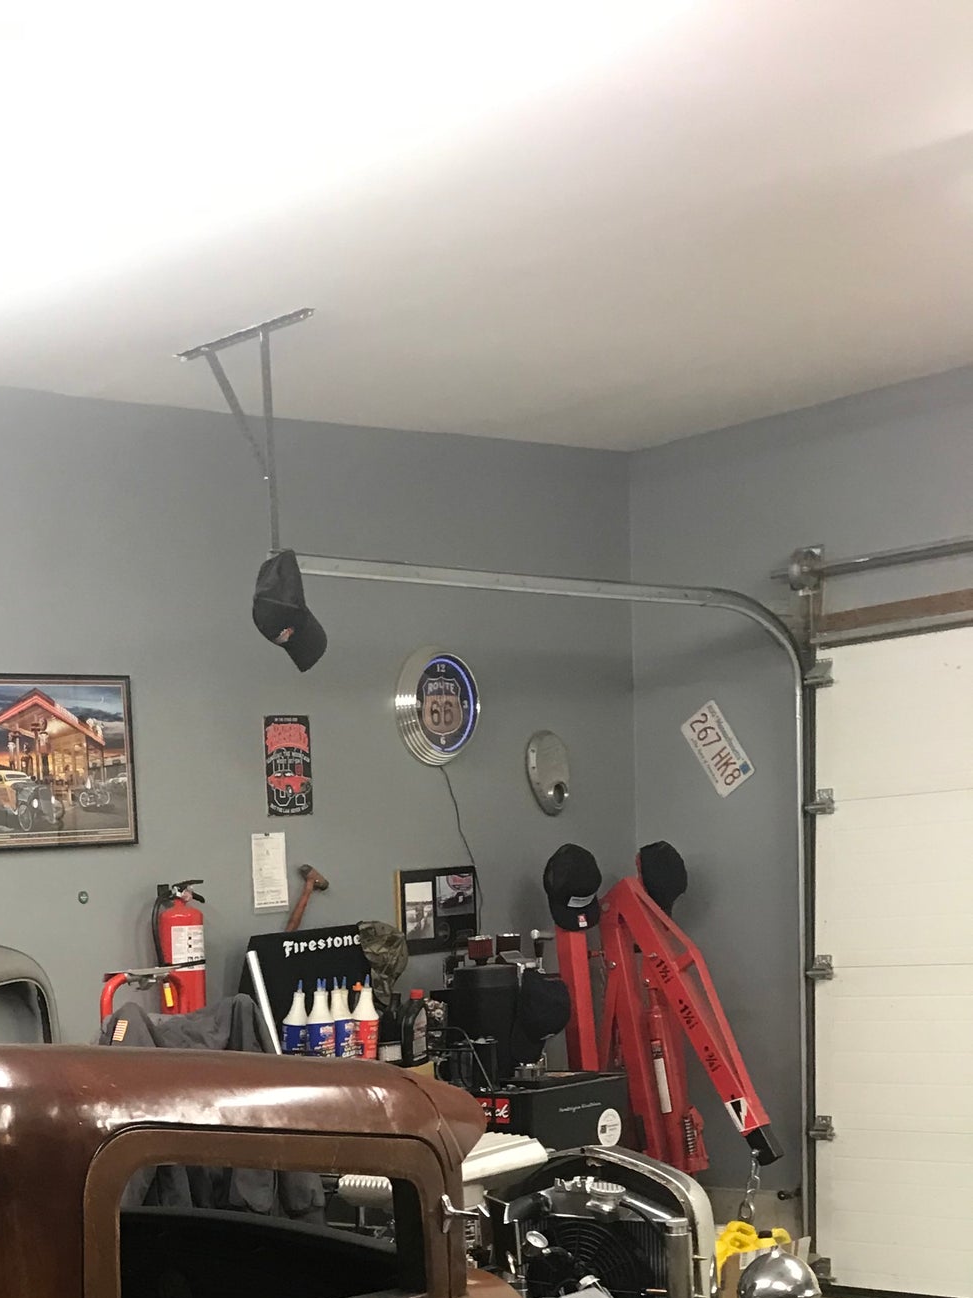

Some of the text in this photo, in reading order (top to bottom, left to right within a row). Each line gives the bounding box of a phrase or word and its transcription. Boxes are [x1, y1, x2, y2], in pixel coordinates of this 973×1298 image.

[436, 664, 446, 673] 12
[427, 682, 456, 695] ROUTE
[431, 701, 454, 726] 66
[440, 737, 446, 745] 6
[689, 712, 741, 786] 267 HK8
[283, 934, 362, 958] Firestone
